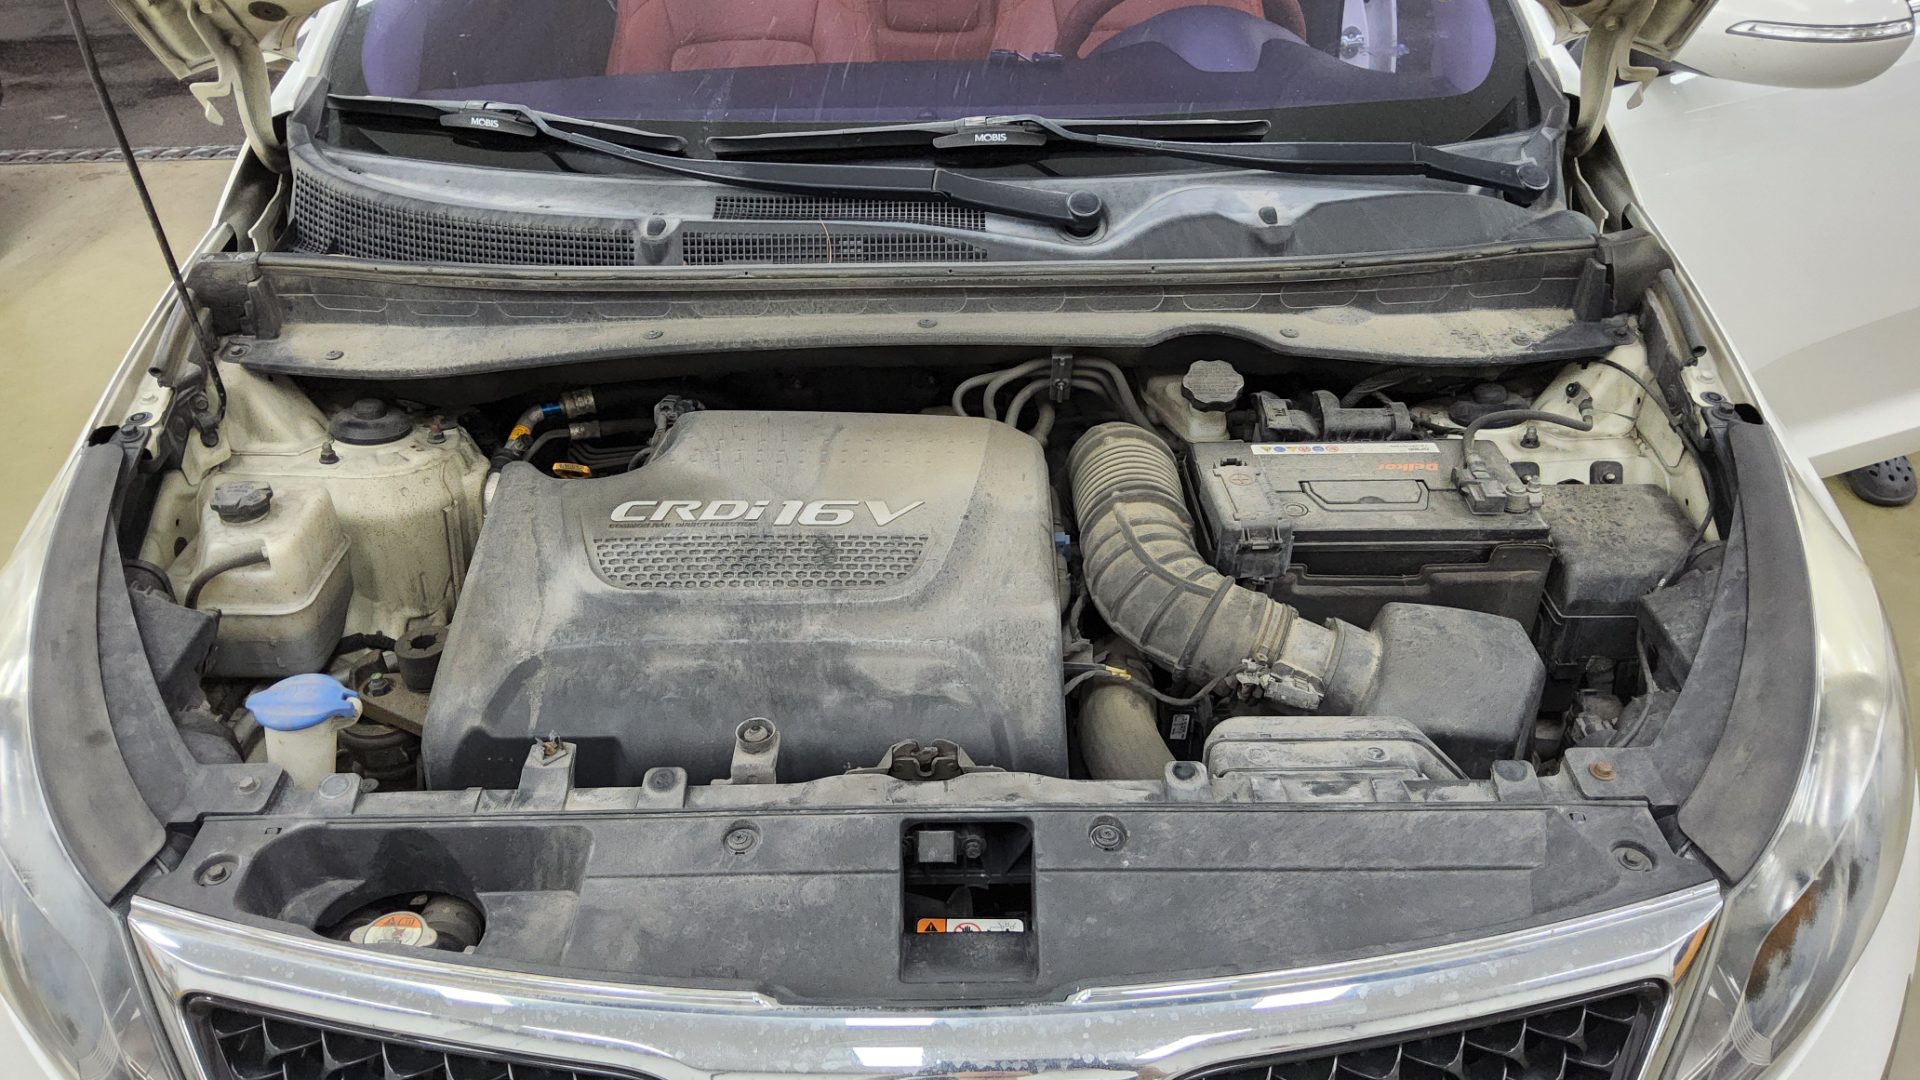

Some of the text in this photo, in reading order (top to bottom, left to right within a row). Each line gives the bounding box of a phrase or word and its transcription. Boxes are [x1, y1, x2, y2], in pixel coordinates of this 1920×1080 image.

[470, 117, 499, 128] MOBIS
[974, 133, 1008, 143] MOBIS
[1376, 462, 1440, 473] Delkor
